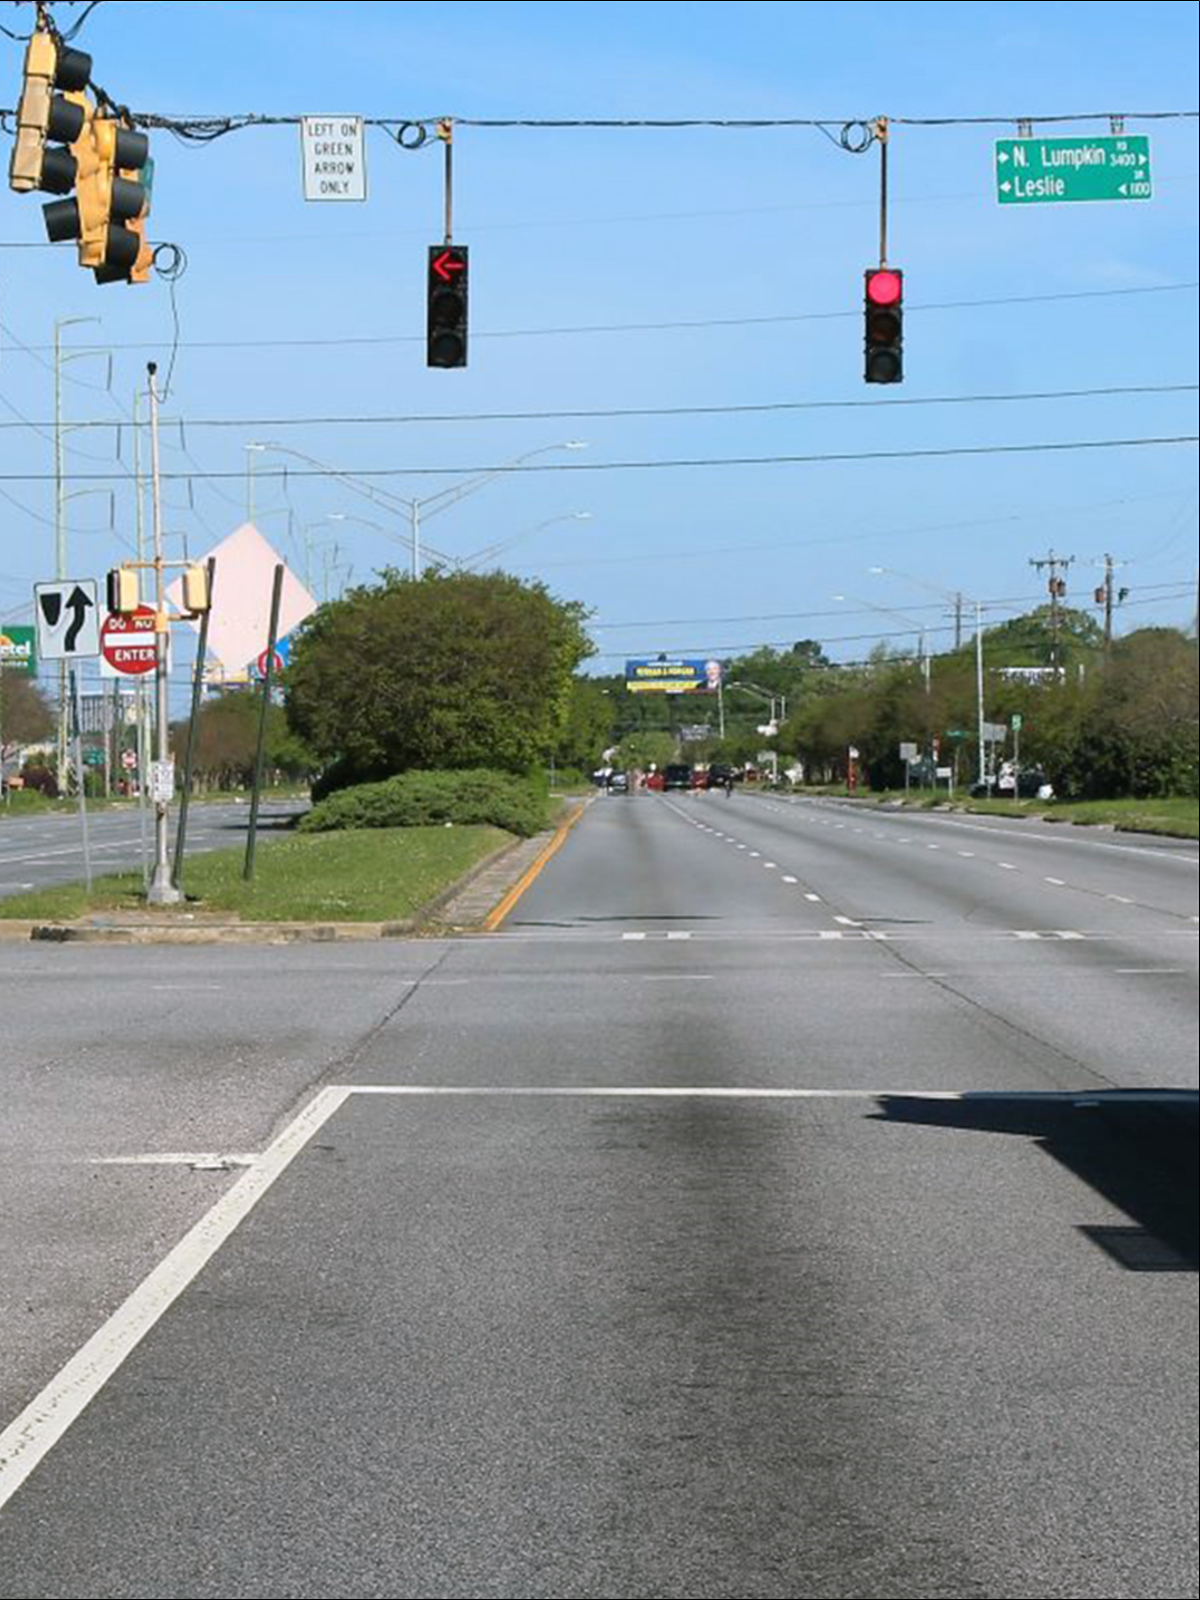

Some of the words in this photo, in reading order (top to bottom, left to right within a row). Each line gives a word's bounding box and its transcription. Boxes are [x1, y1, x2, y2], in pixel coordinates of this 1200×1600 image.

[308, 123, 333, 137] LEFT
[341, 123, 357, 137] ON
[314, 142, 353, 155] GREEN
[1013, 145, 1029, 167] N.
[1040, 143, 1105, 171] Lumpkin
[1110, 153, 1136, 167] 3400
[314, 162, 354, 175] ARROW
[320, 180, 349, 194] ONLY
[1014, 175, 1064, 197] Leslie
[109, 618, 126, 630] DO
[115, 649, 155, 661] ENTER
